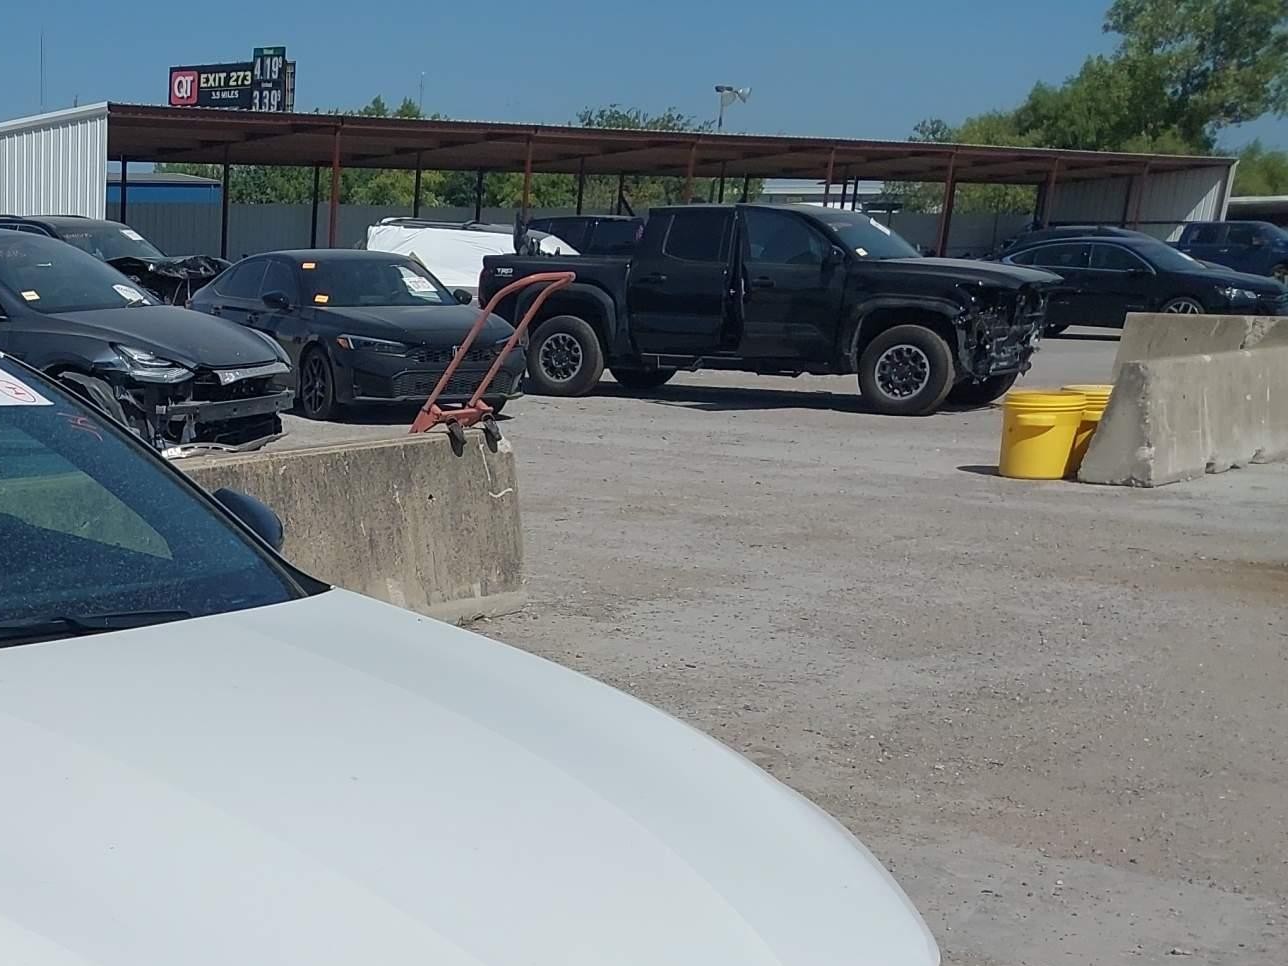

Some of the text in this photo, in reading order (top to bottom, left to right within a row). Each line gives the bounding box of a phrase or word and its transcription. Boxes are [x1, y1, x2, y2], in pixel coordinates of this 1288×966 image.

[174, 76, 193, 99] QT
[200, 71, 252, 88] EXIT 273
[221, 90, 240, 99] MILES
